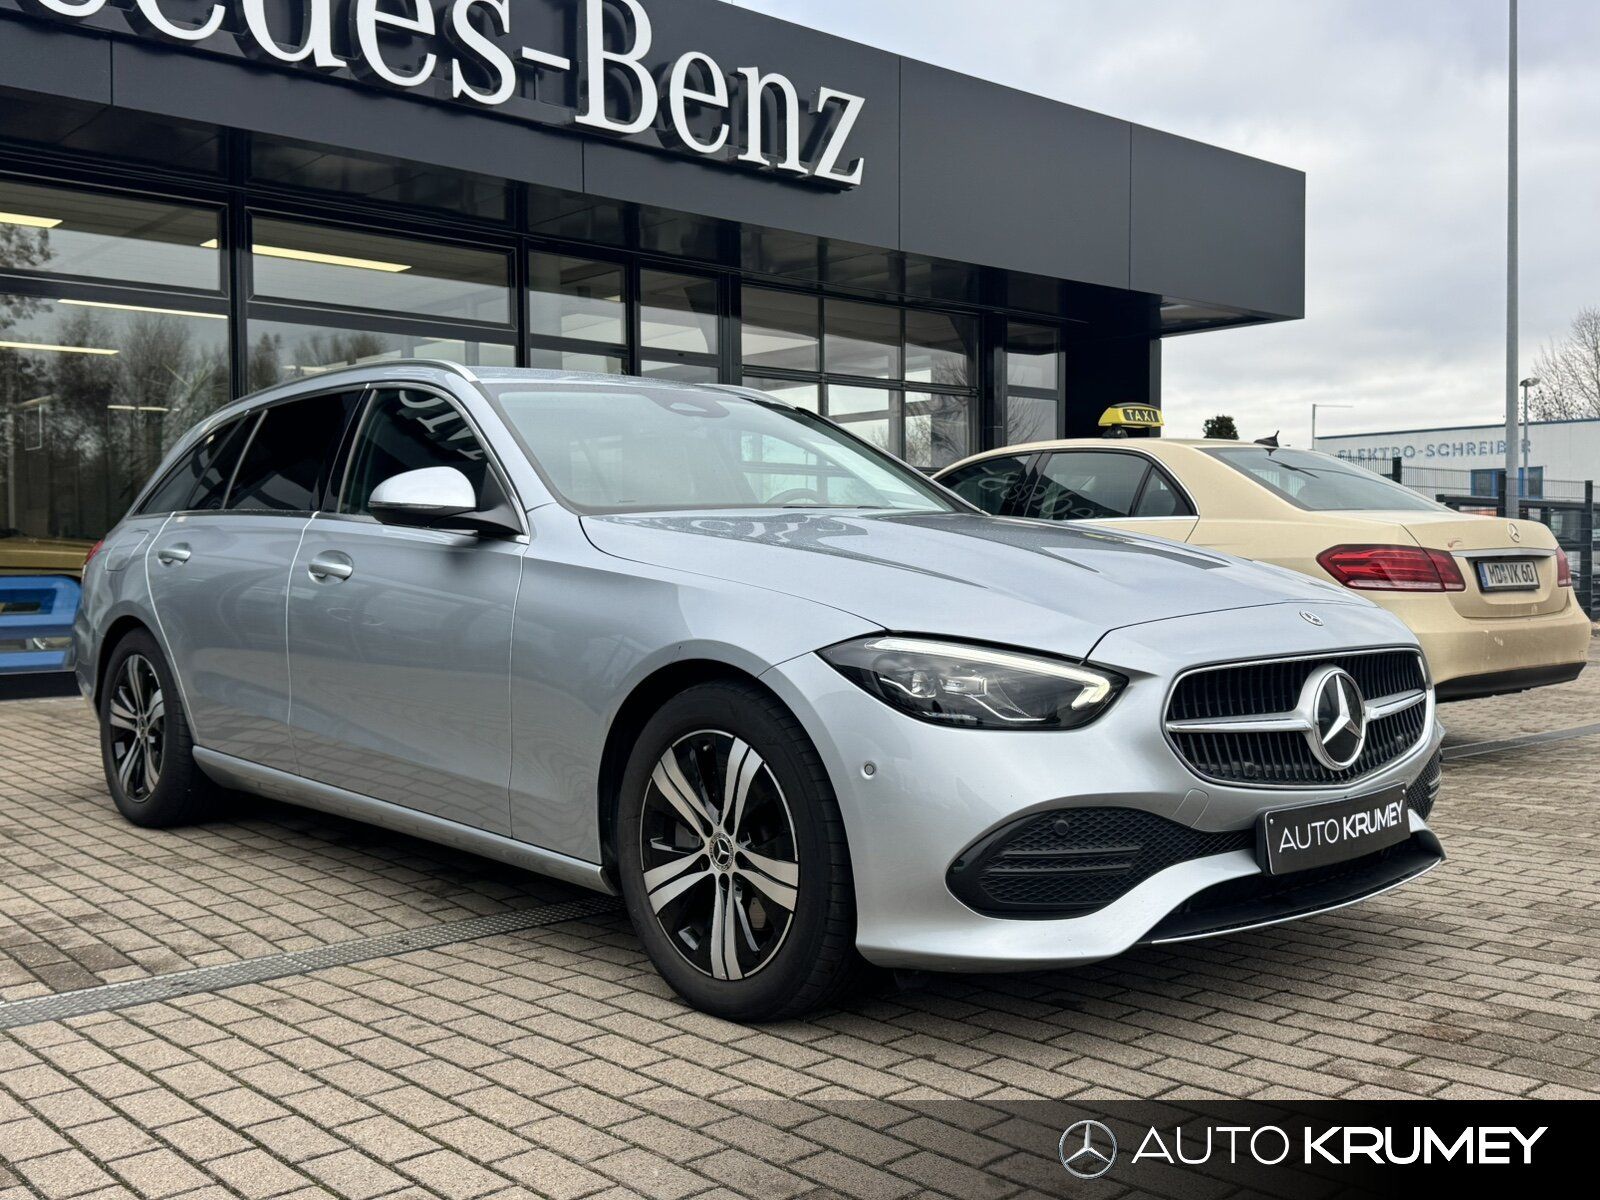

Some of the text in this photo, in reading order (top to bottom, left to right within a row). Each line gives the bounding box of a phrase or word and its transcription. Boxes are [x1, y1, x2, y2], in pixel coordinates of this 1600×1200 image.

[1126, 409, 1156, 422] TAXI
[1337, 439, 1531, 461] ELEKTRO-SCHREIBR
[1505, 564, 1522, 584] VK
[1279, 799, 1404, 854] AUTO KRUMEY
